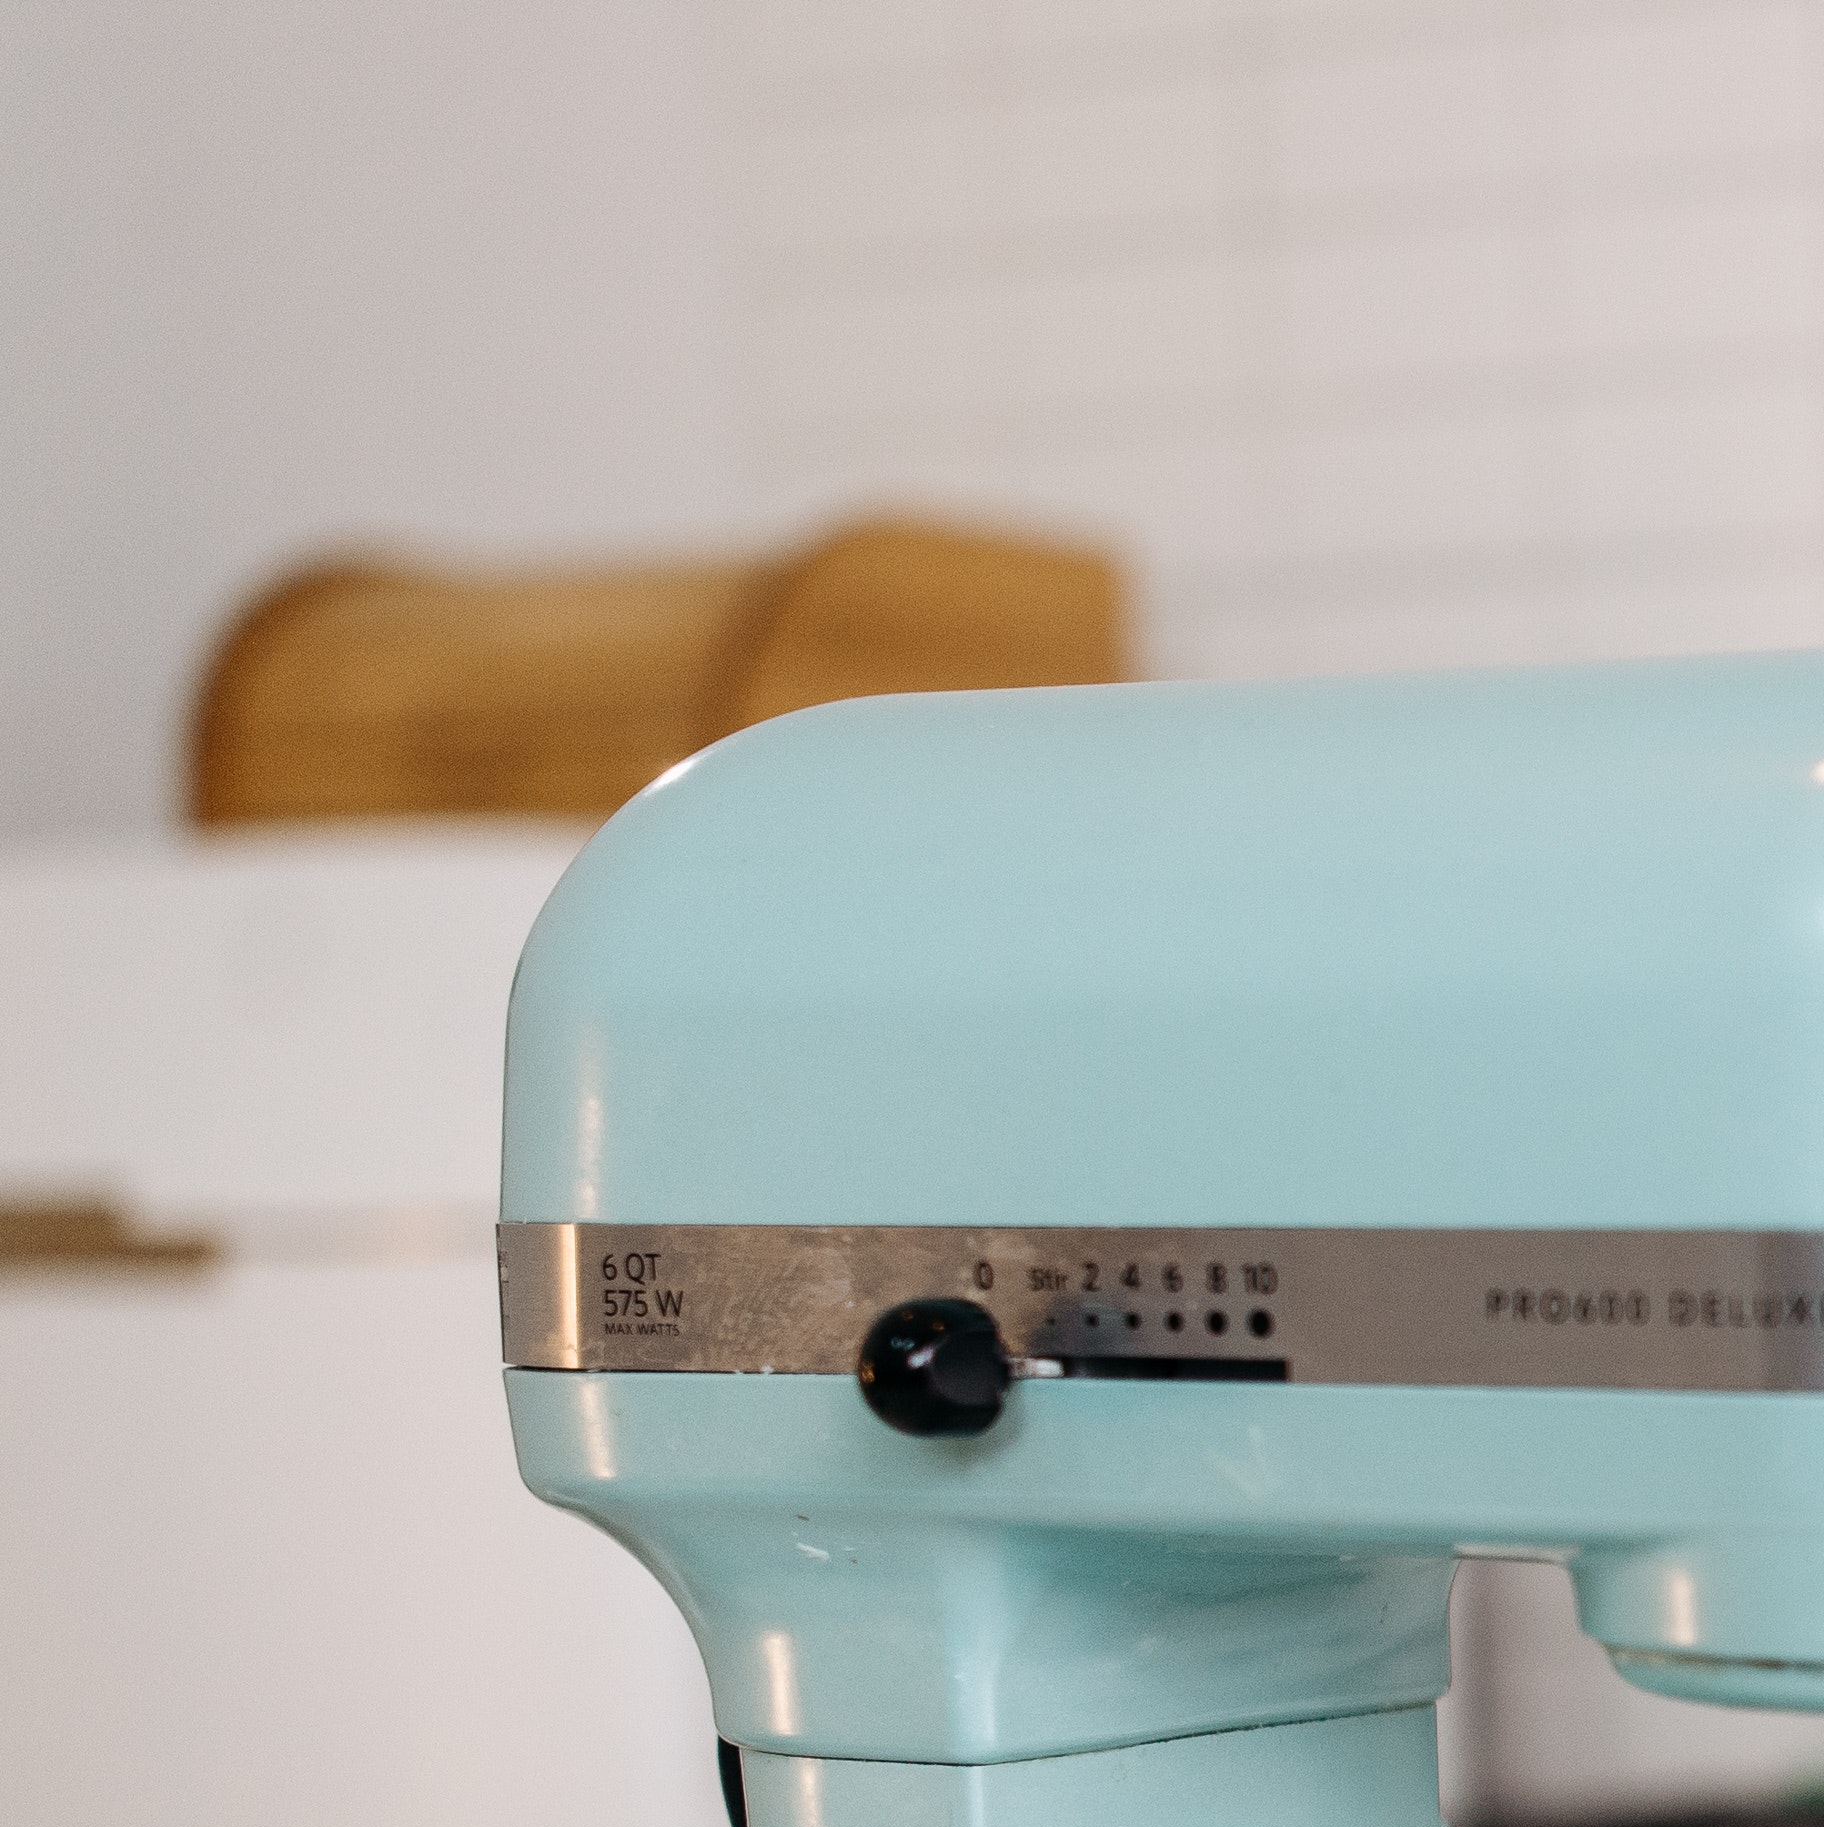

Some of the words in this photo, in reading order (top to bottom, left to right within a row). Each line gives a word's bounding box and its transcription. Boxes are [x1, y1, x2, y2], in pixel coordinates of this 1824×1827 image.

[602, 1253, 618, 1280] 6
[625, 1253, 661, 1286] QT
[973, 1261, 995, 1291] 0
[1027, 1266, 1068, 1292] Stir
[1082, 1262, 1100, 1292] 2
[1118, 1262, 1141, 1290] 4
[1162, 1262, 1184, 1293] 6
[1204, 1261, 1230, 1294] 8
[1241, 1262, 1279, 1295] 10
[604, 1289, 648, 1318] 575
[655, 1289, 684, 1318] W
[604, 1323, 635, 1336] MAX
[637, 1323, 680, 1337] WATTS
